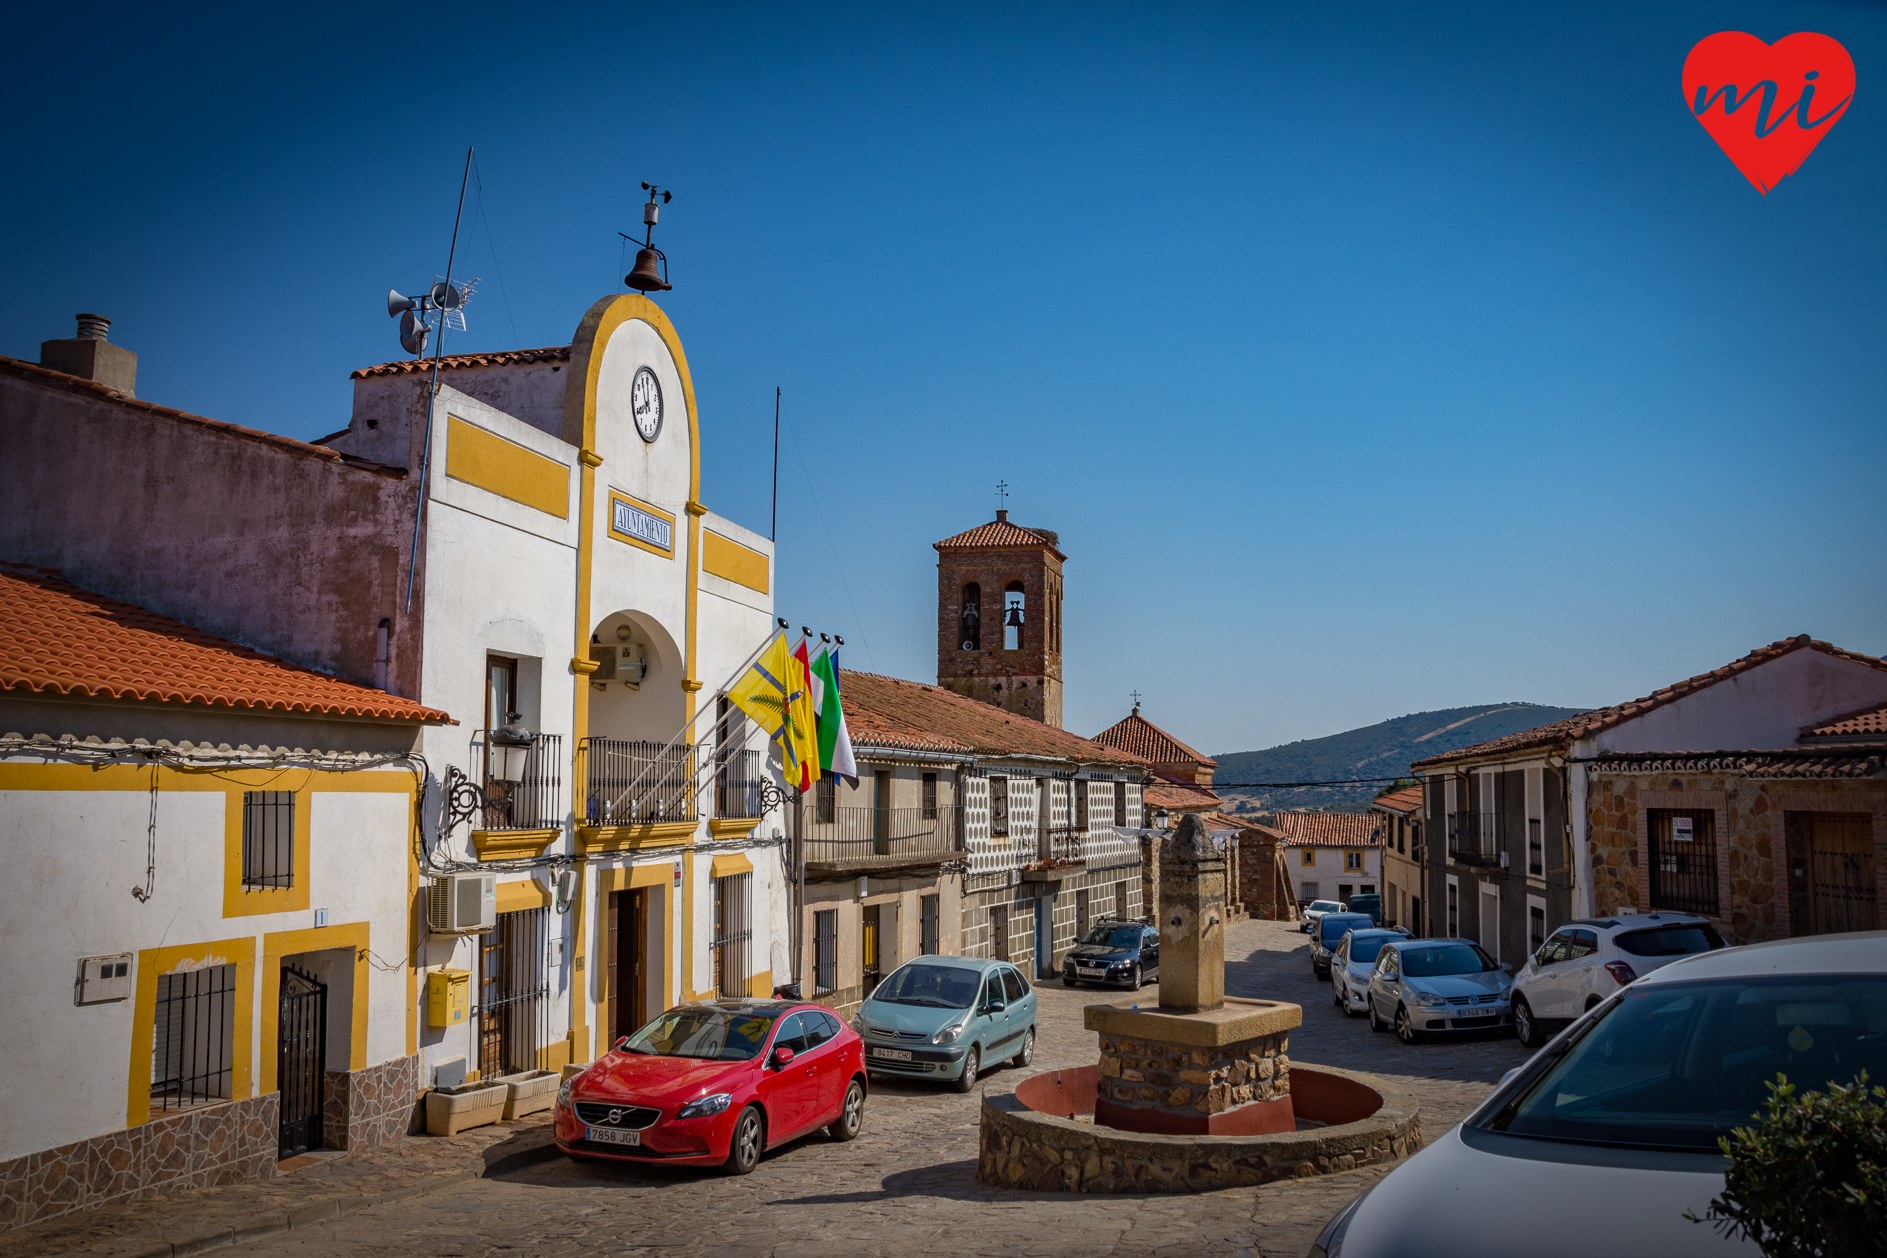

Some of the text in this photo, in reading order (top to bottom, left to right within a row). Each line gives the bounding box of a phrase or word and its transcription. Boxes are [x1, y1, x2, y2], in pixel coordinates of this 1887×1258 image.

[617, 507, 668, 544] AYUNTAMIENTO
[1674, 819, 1691, 827] SE VENDE
[877, 1049, 894, 1058] 8417
[592, 1129, 638, 1144] 7858 JGV
